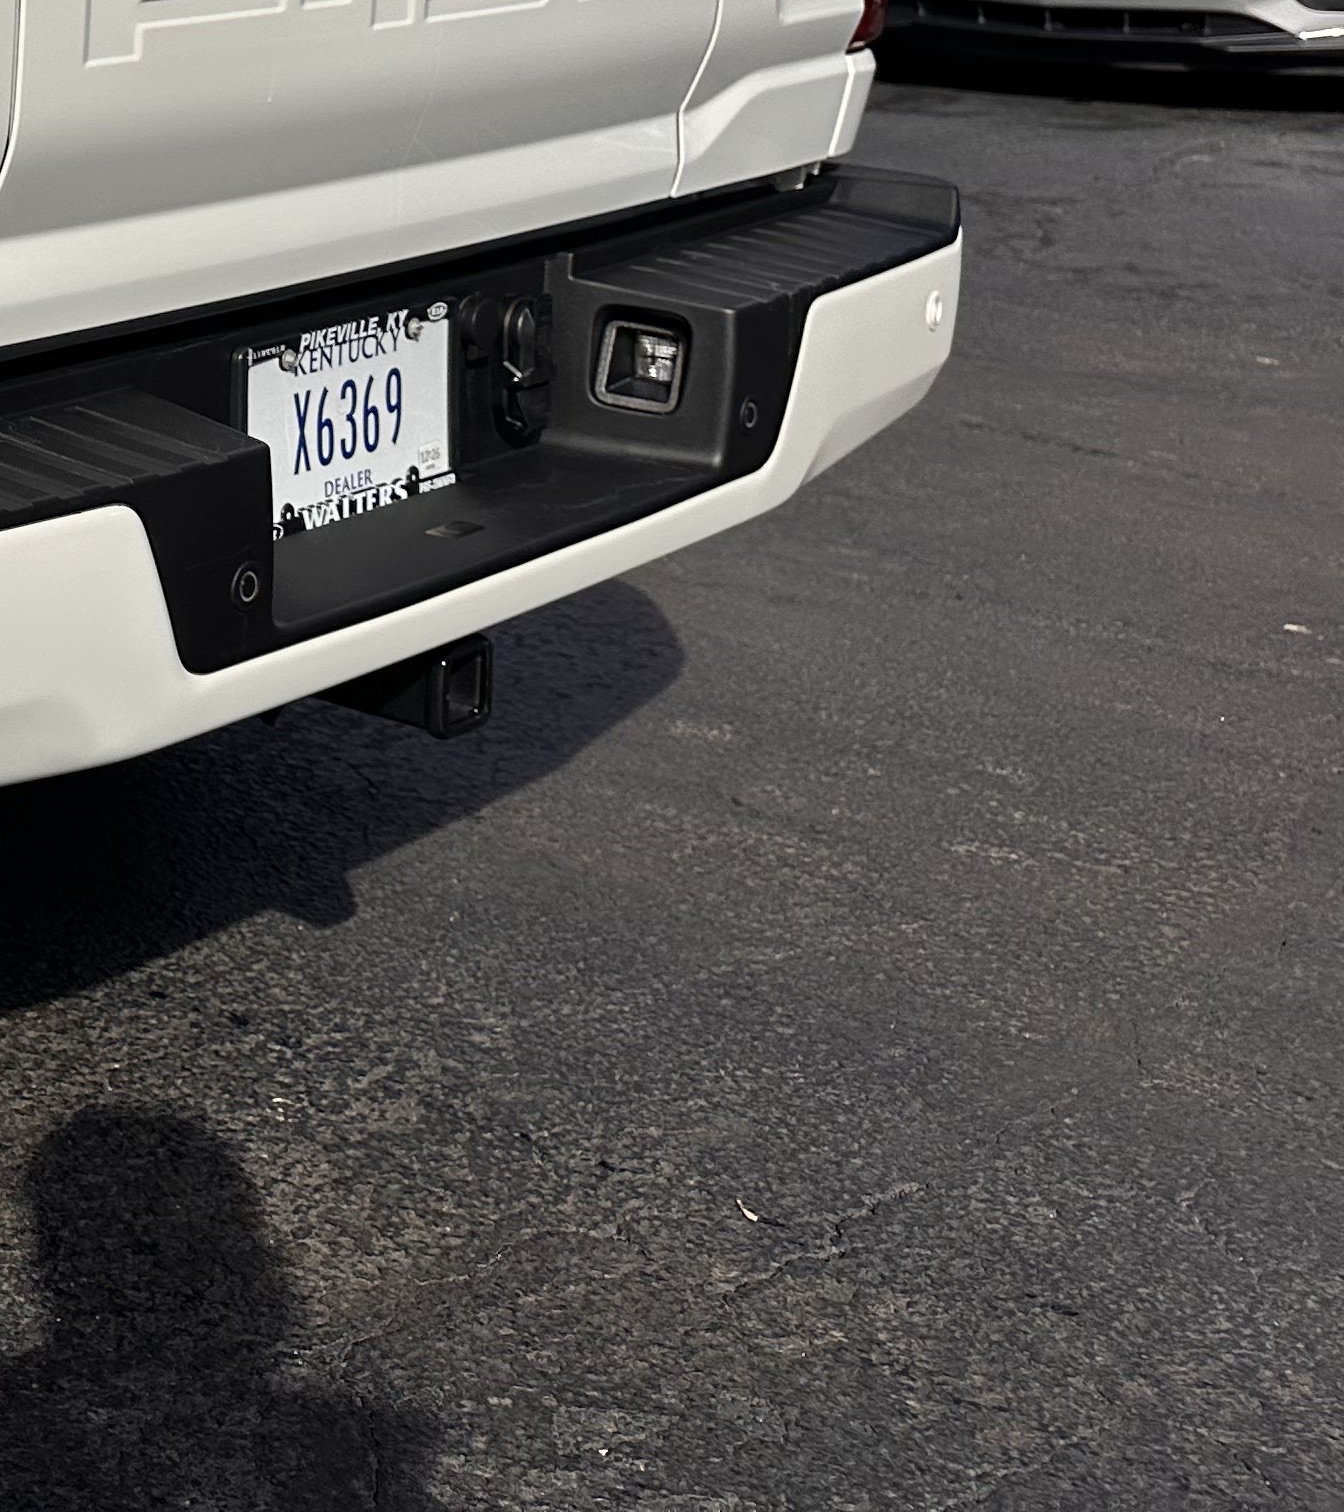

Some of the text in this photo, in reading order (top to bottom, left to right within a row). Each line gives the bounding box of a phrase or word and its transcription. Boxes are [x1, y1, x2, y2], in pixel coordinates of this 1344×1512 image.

[386, 308, 409, 334] KY
[295, 329, 400, 377] KENTUCKY
[294, 367, 403, 475] X6369
[324, 468, 373, 498] DEALER
